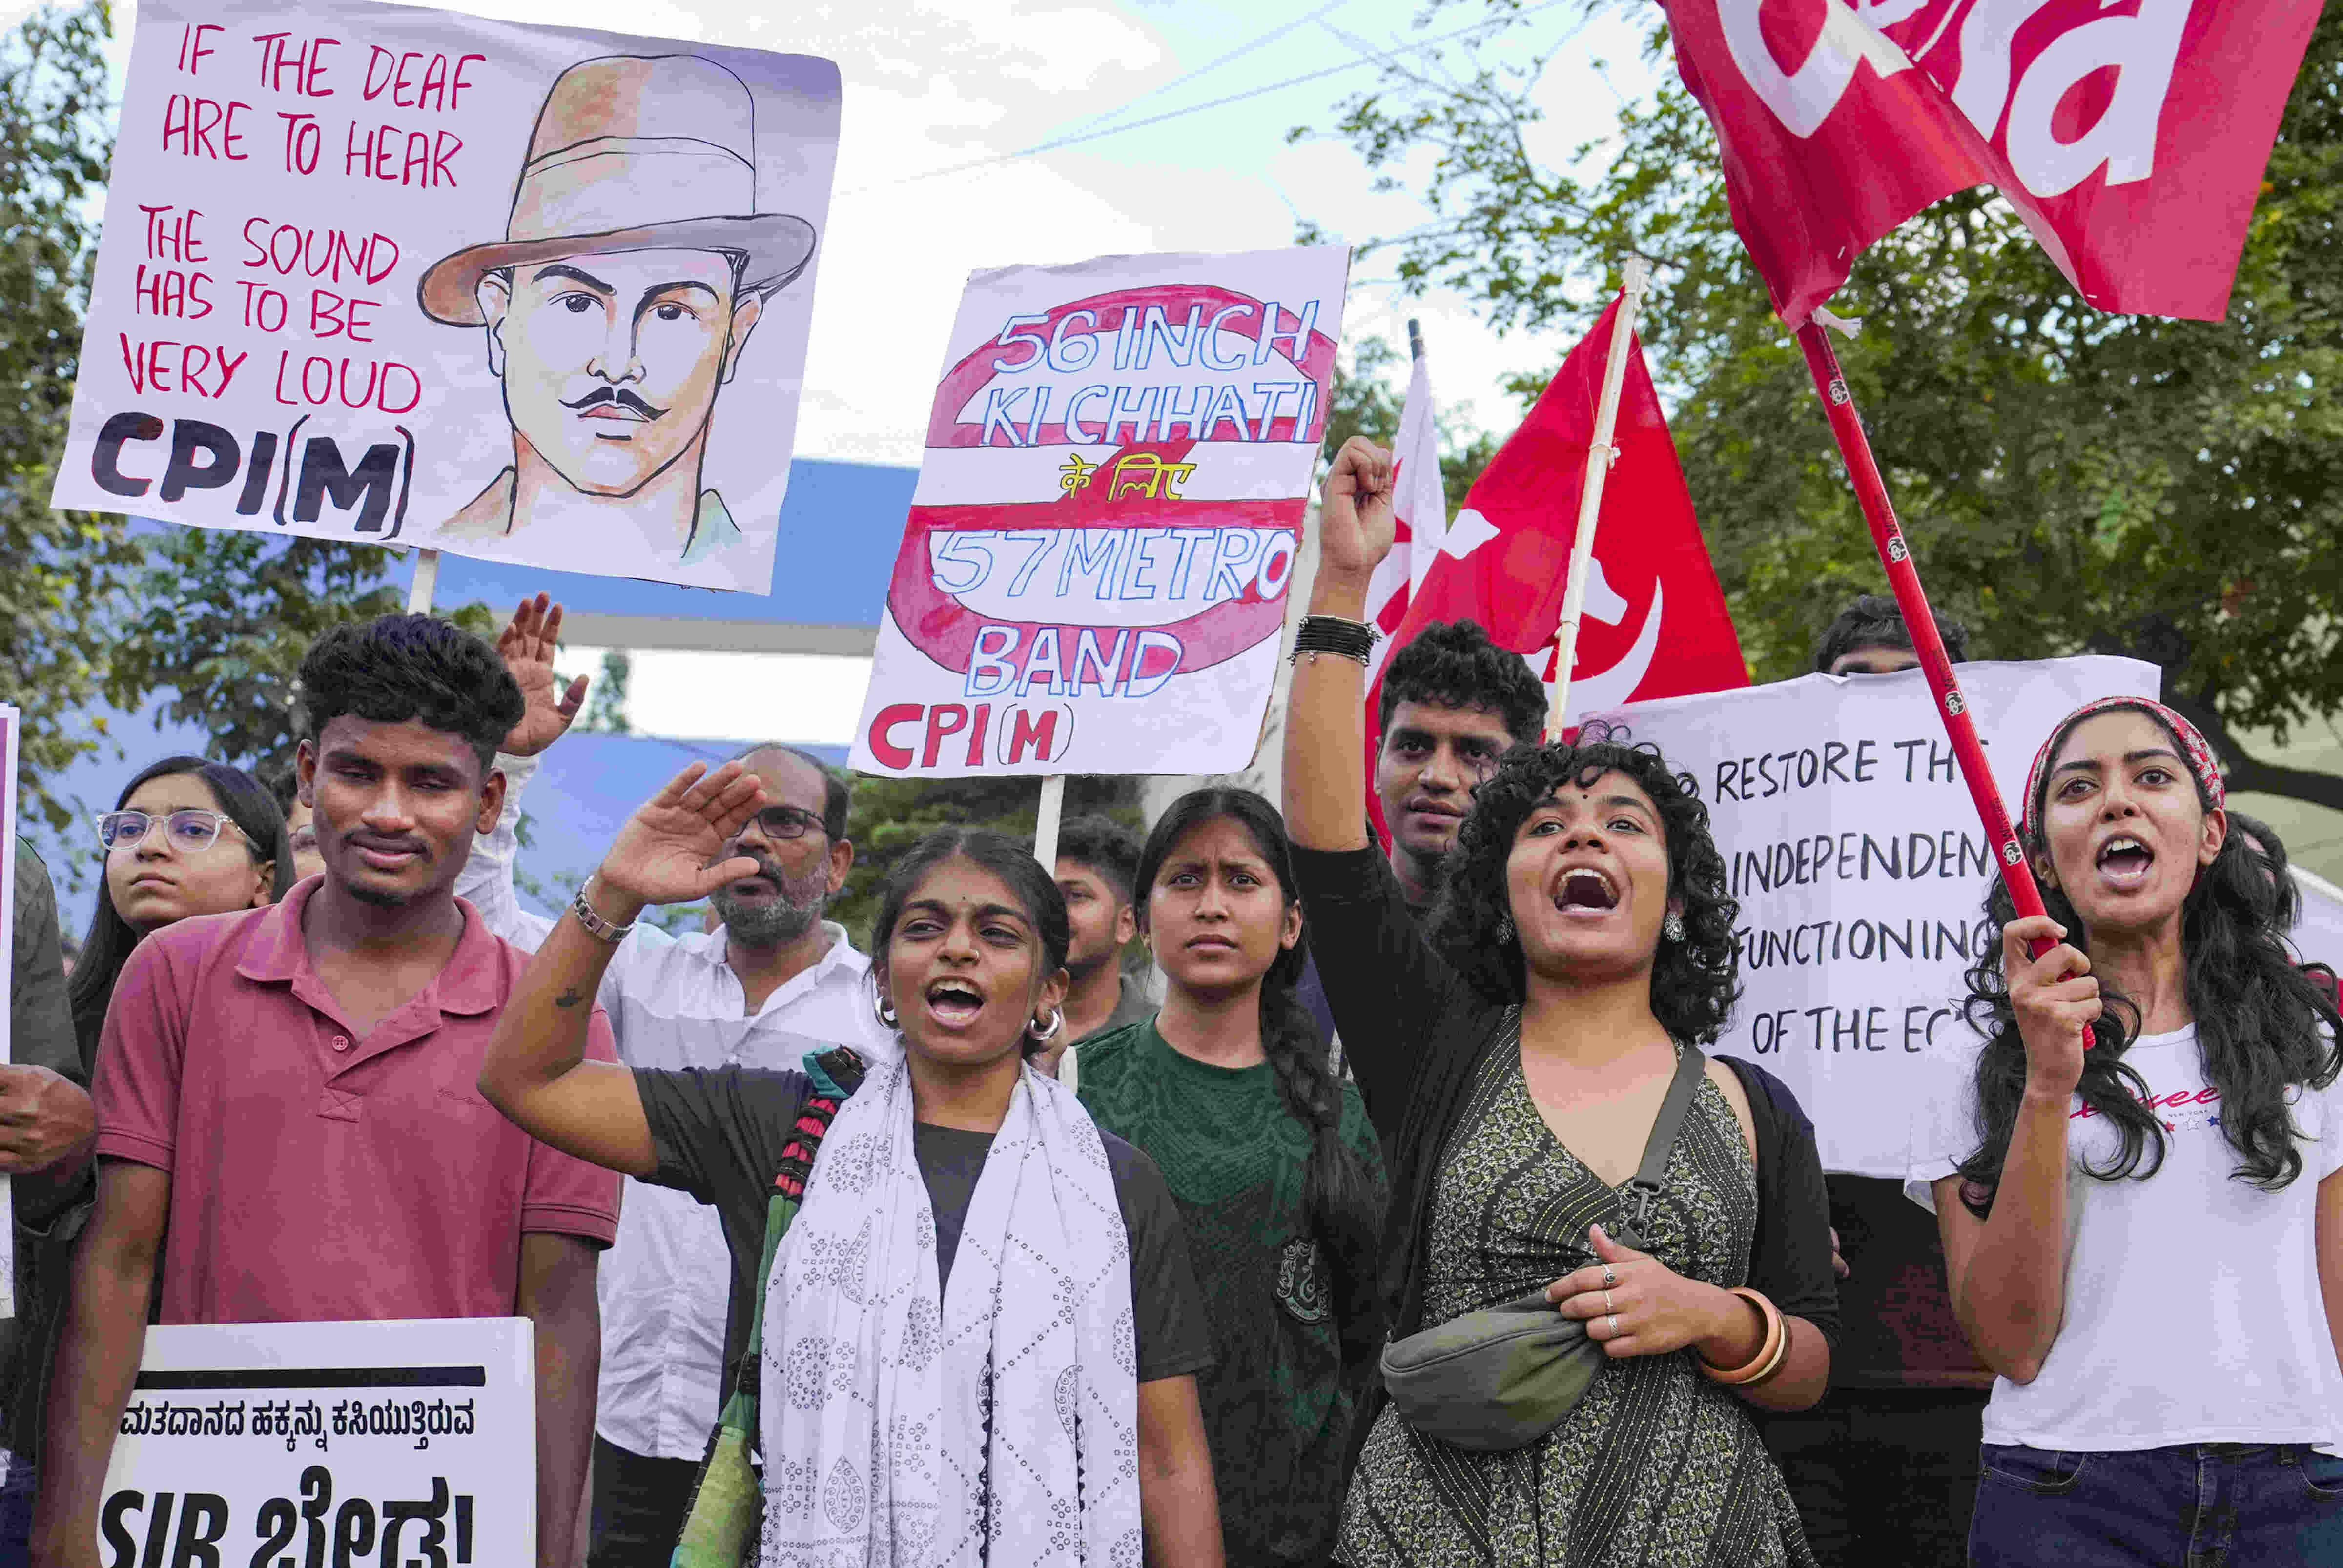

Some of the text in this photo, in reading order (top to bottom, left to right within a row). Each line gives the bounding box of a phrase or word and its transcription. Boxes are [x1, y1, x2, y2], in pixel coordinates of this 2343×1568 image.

[178, 24, 486, 113] IF THE DEAF
[164, 94, 463, 188] ARE TO HEAR
[138, 204, 399, 285] THE SOUND
[136, 264, 382, 343] HAS TO BE
[119, 332, 421, 414] VERY LOUD
[91, 412, 415, 541] CPI(M)
[1059, 452, 1197, 503] के लिए
[964, 624, 1184, 698] BAND
[868, 703, 1074, 770] CPI(M)
[1715, 738, 1989, 805] RESTORE TH
[1732, 830, 1989, 899] INDEPENDEN
[1753, 1006, 1964, 1055] OF THE EC
[120, 1400, 245, 1436] ಮತದಾನದ
[252, 1399, 328, 1452] ಹಕ್ಕನ್ನು
[101, 1490, 229, 1568] SIR
